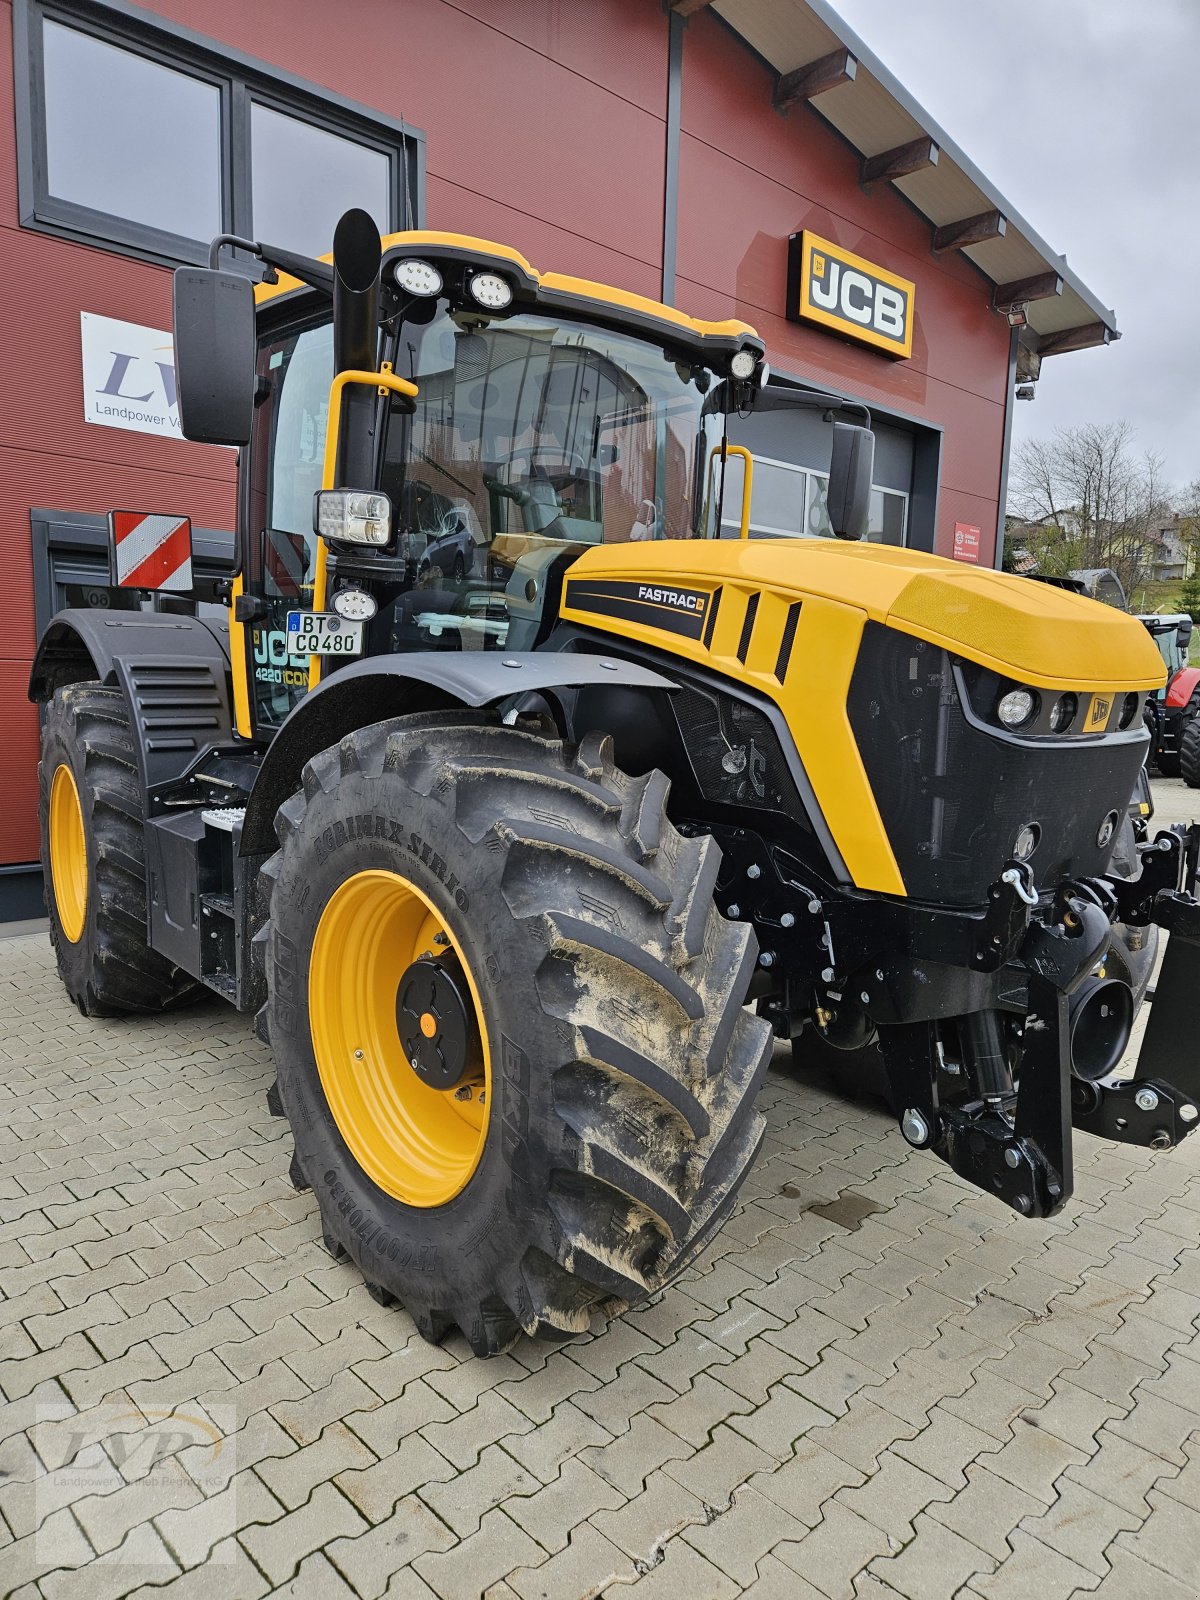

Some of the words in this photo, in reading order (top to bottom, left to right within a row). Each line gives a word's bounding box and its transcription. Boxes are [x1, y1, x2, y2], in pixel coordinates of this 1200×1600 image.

[812, 262, 904, 337] JCB
[95, 401, 166, 426] Landpower
[638, 586, 697, 609] FASTRAC
[303, 616, 327, 634] BT
[255, 667, 282, 684] 4220
[313, 814, 404, 866] AGRIMAX
